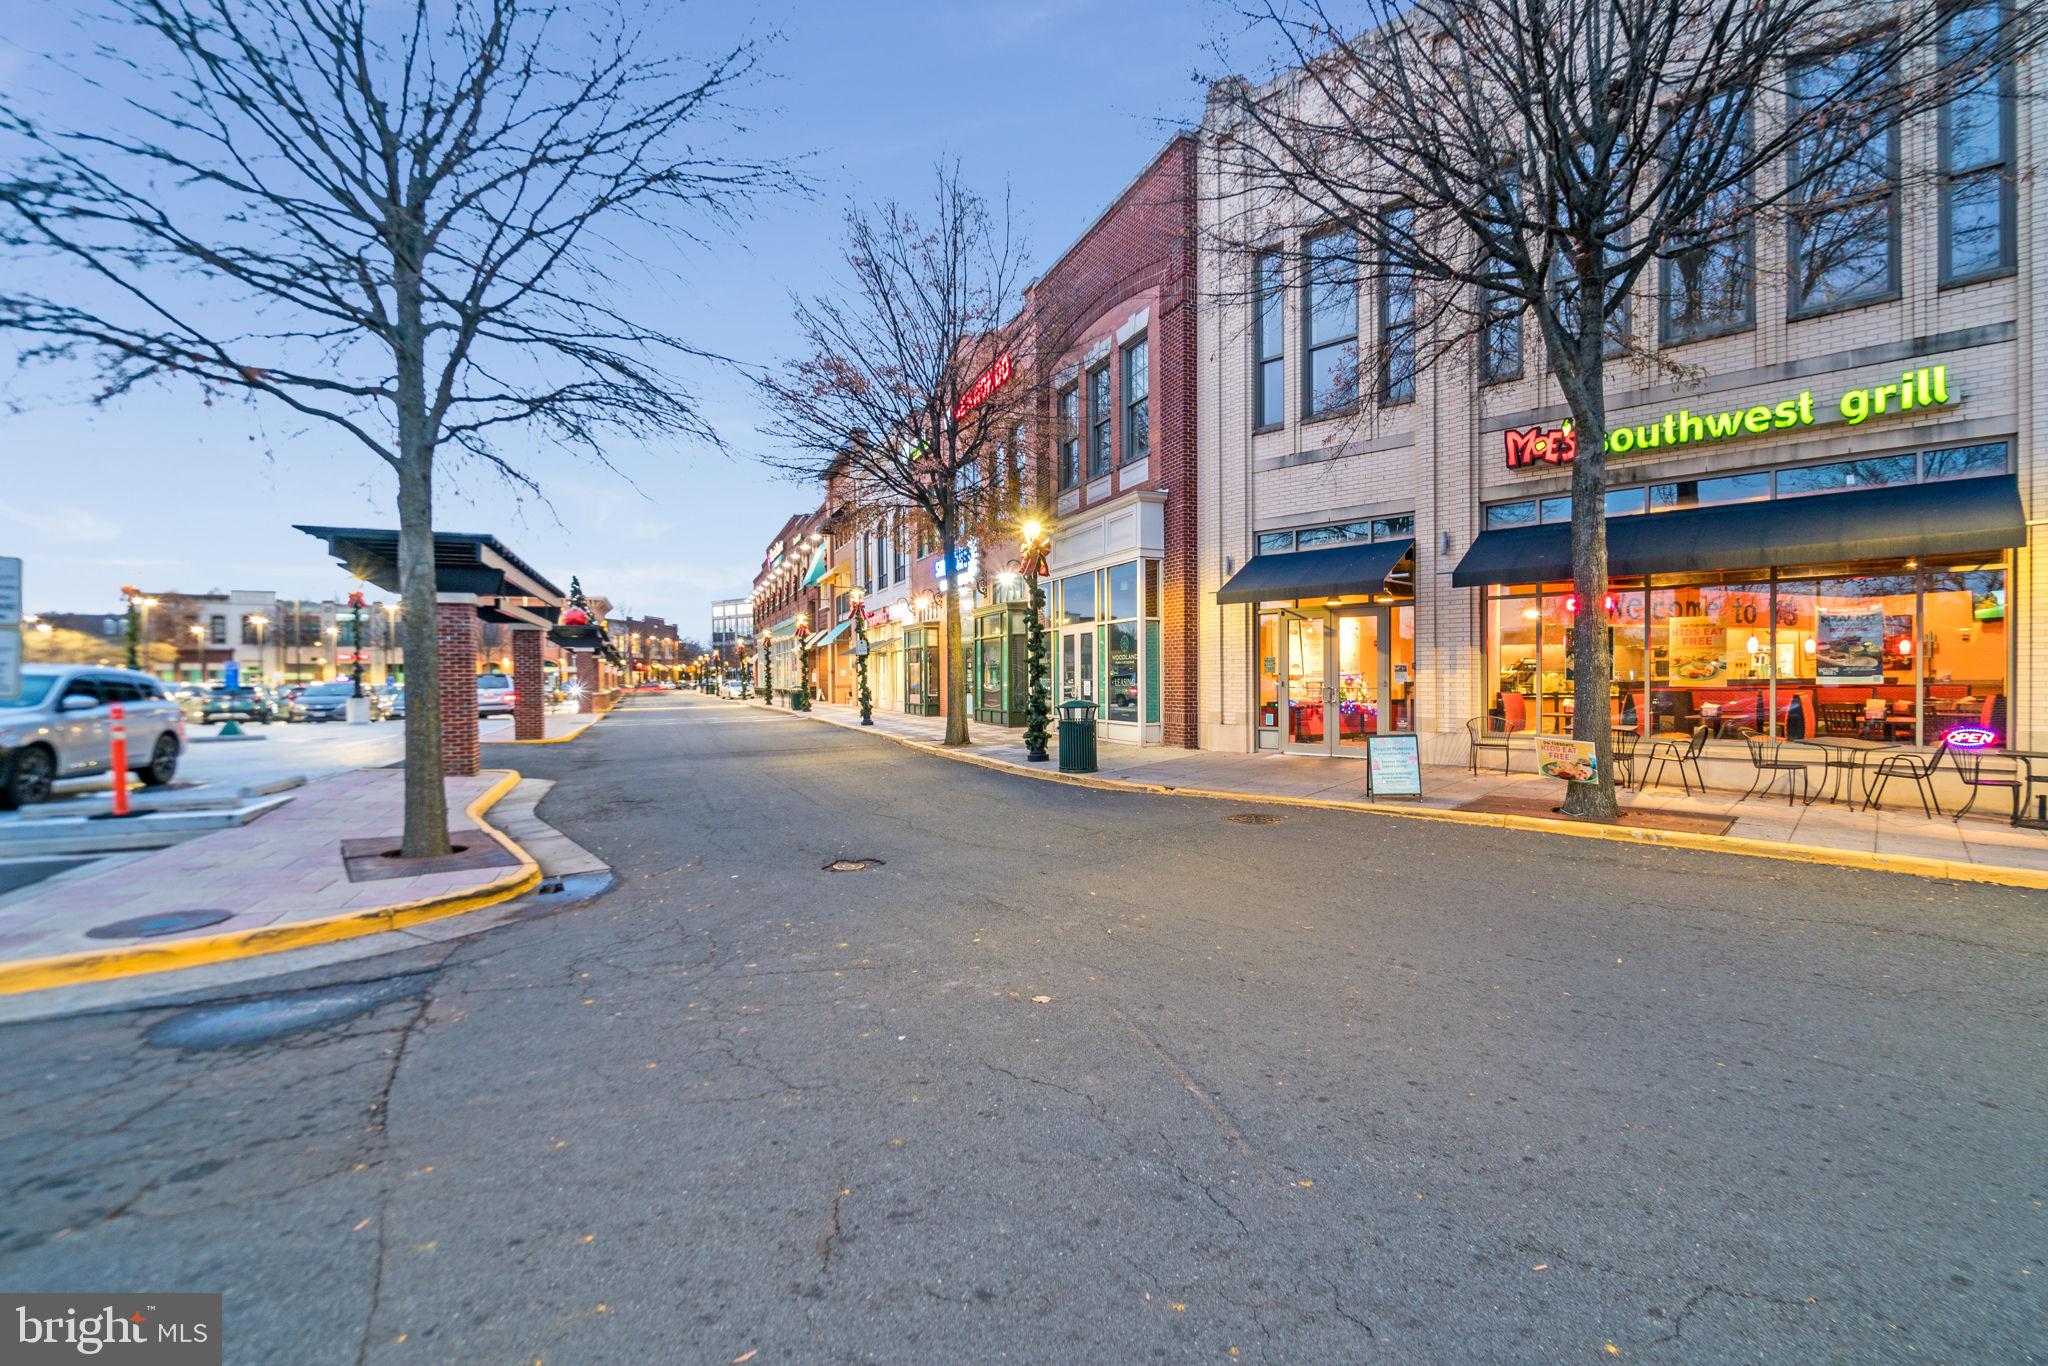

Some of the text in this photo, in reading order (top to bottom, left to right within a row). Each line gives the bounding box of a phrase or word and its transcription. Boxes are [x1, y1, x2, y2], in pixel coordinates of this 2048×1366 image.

[1840, 365, 1948, 425] grill
[1733, 597, 1757, 624] to
[1703, 627, 1724, 636] EAT
[1682, 636, 1713, 646] FREE
[1946, 732, 1995, 744] OPEN
[1548, 752, 1571, 761] FREE
